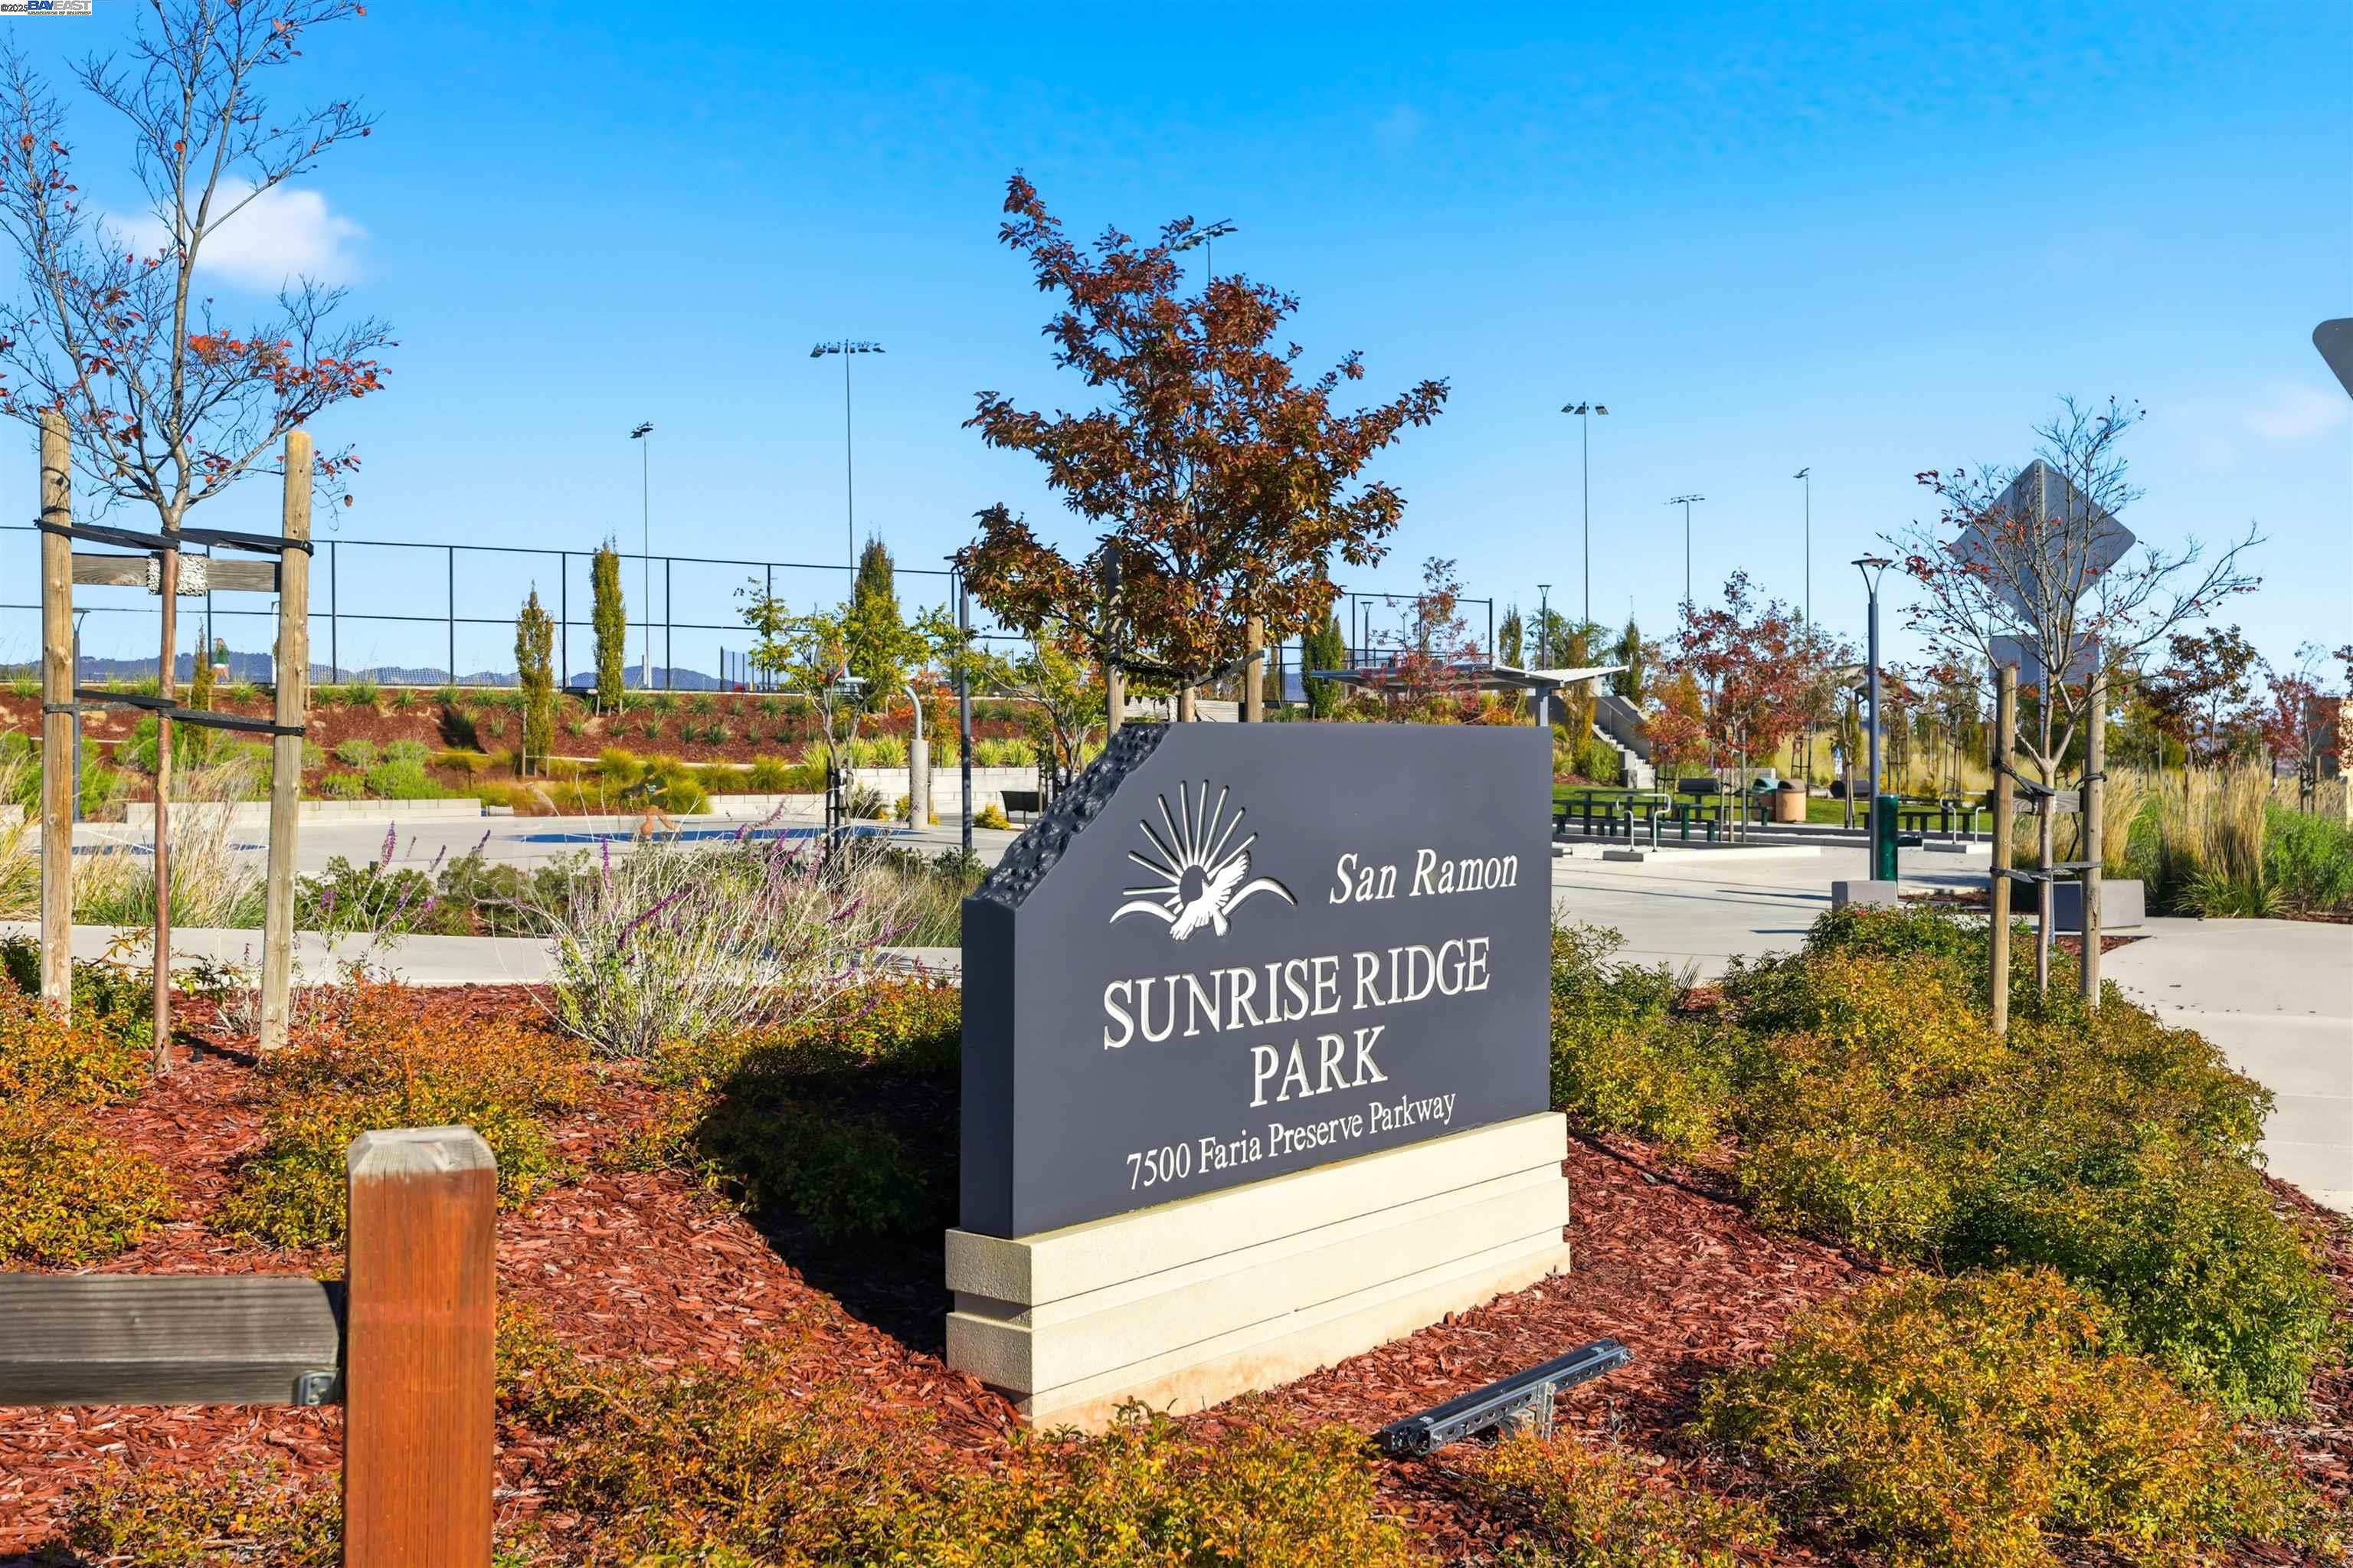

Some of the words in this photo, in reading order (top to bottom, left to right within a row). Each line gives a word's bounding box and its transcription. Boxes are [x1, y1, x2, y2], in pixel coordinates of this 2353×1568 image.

[1330, 853, 1396, 905] San
[1409, 848, 1517, 897] Ramon
[1104, 955, 1341, 1050] SUNRISE
[1353, 937, 1491, 1010] RIDGE
[1250, 1025, 1388, 1108] PARK
[1127, 1142, 1191, 1190] 7500
[1198, 1129, 1262, 1174] Faria
[1268, 1111, 1363, 1157] Preserve
[1369, 1092, 1456, 1133] Parkway
